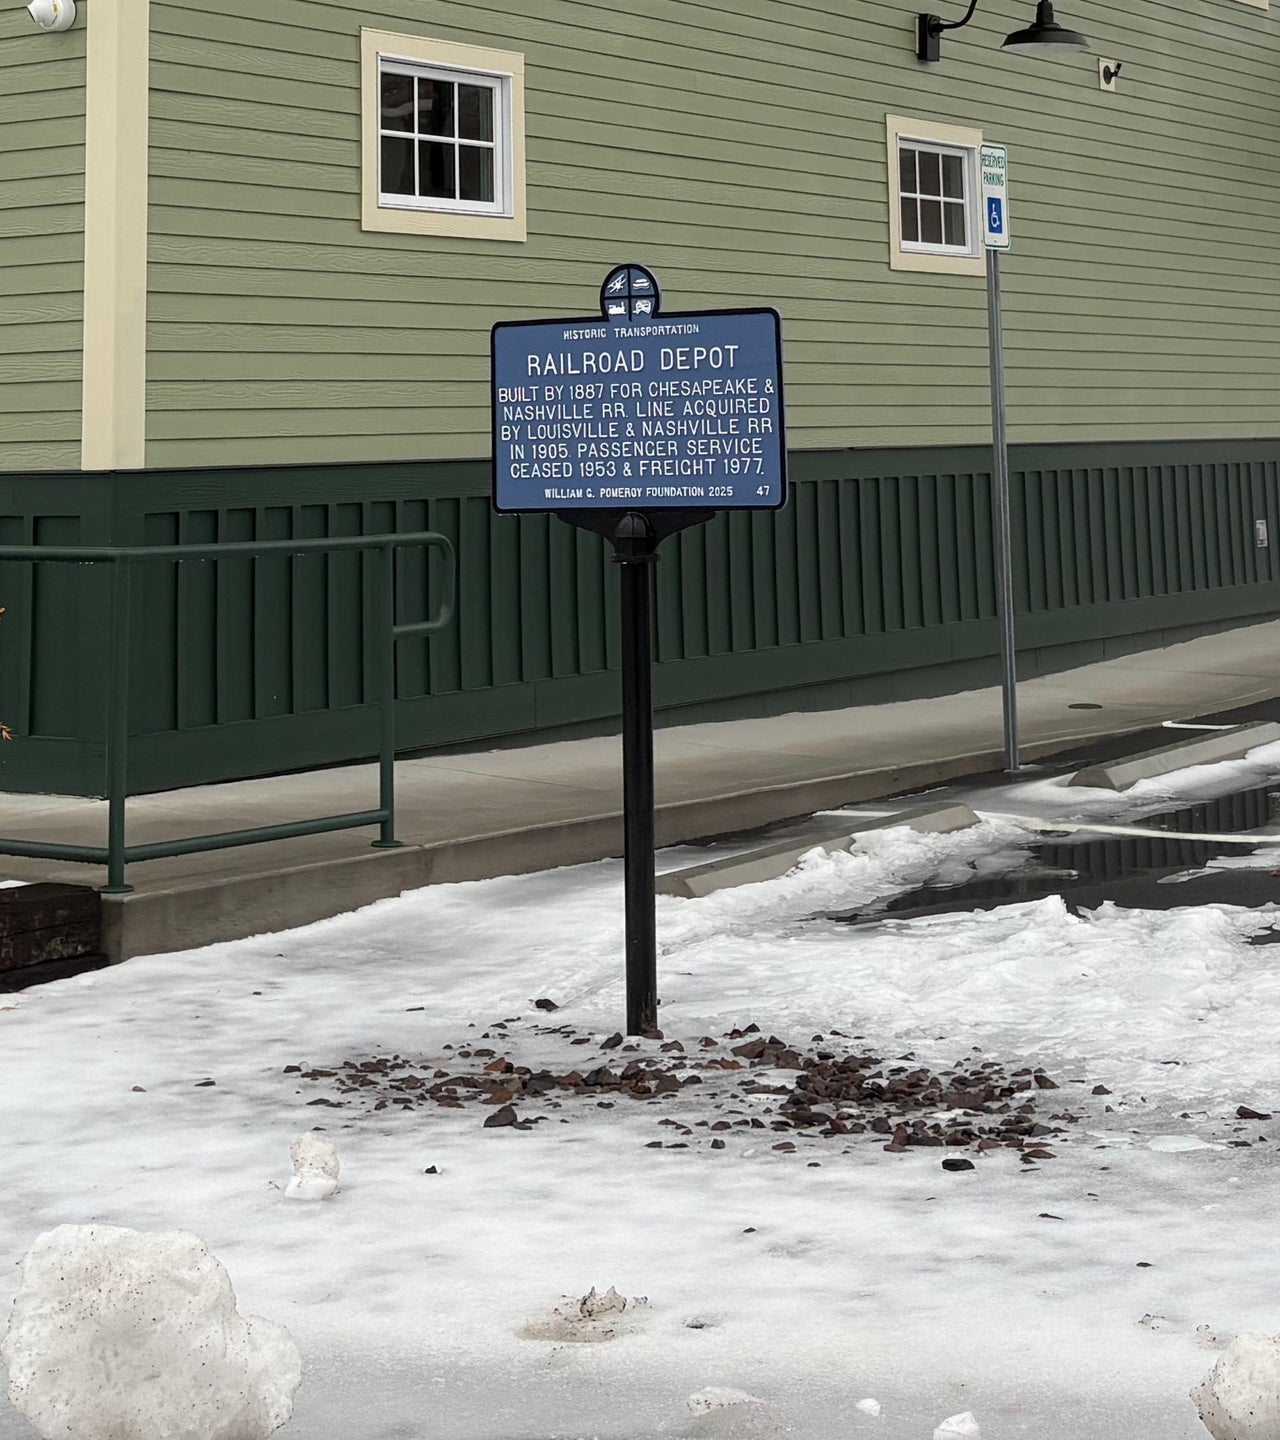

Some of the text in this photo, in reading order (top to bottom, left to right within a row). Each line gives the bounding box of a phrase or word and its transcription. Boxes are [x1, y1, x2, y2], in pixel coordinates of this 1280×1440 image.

[981, 154, 1004, 168] RESERVED
[984, 172, 1004, 186] PARKING
[564, 324, 699, 340] HISTORIC TRANSPORTATION
[527, 345, 739, 376] RAILROAD DEPOT
[498, 379, 774, 403] BUILT BY 1887 FOR CHESAPEAKE &
[504, 398, 770, 421] NASHVILLE RR. LINE ACQUIRED
[501, 418, 773, 441] BY LOUISVILLE & NASHVILLE RR
[510, 445, 525, 459] IN
[578, 441, 678, 458] PASSENGER
[687, 438, 763, 455] SERVICE
[510, 458, 765, 478] CEASED 1953 & FREIGHT 1977.
[545, 486, 770, 498] WILLIAM G. POMEROY FOUNDATION 2025 47
